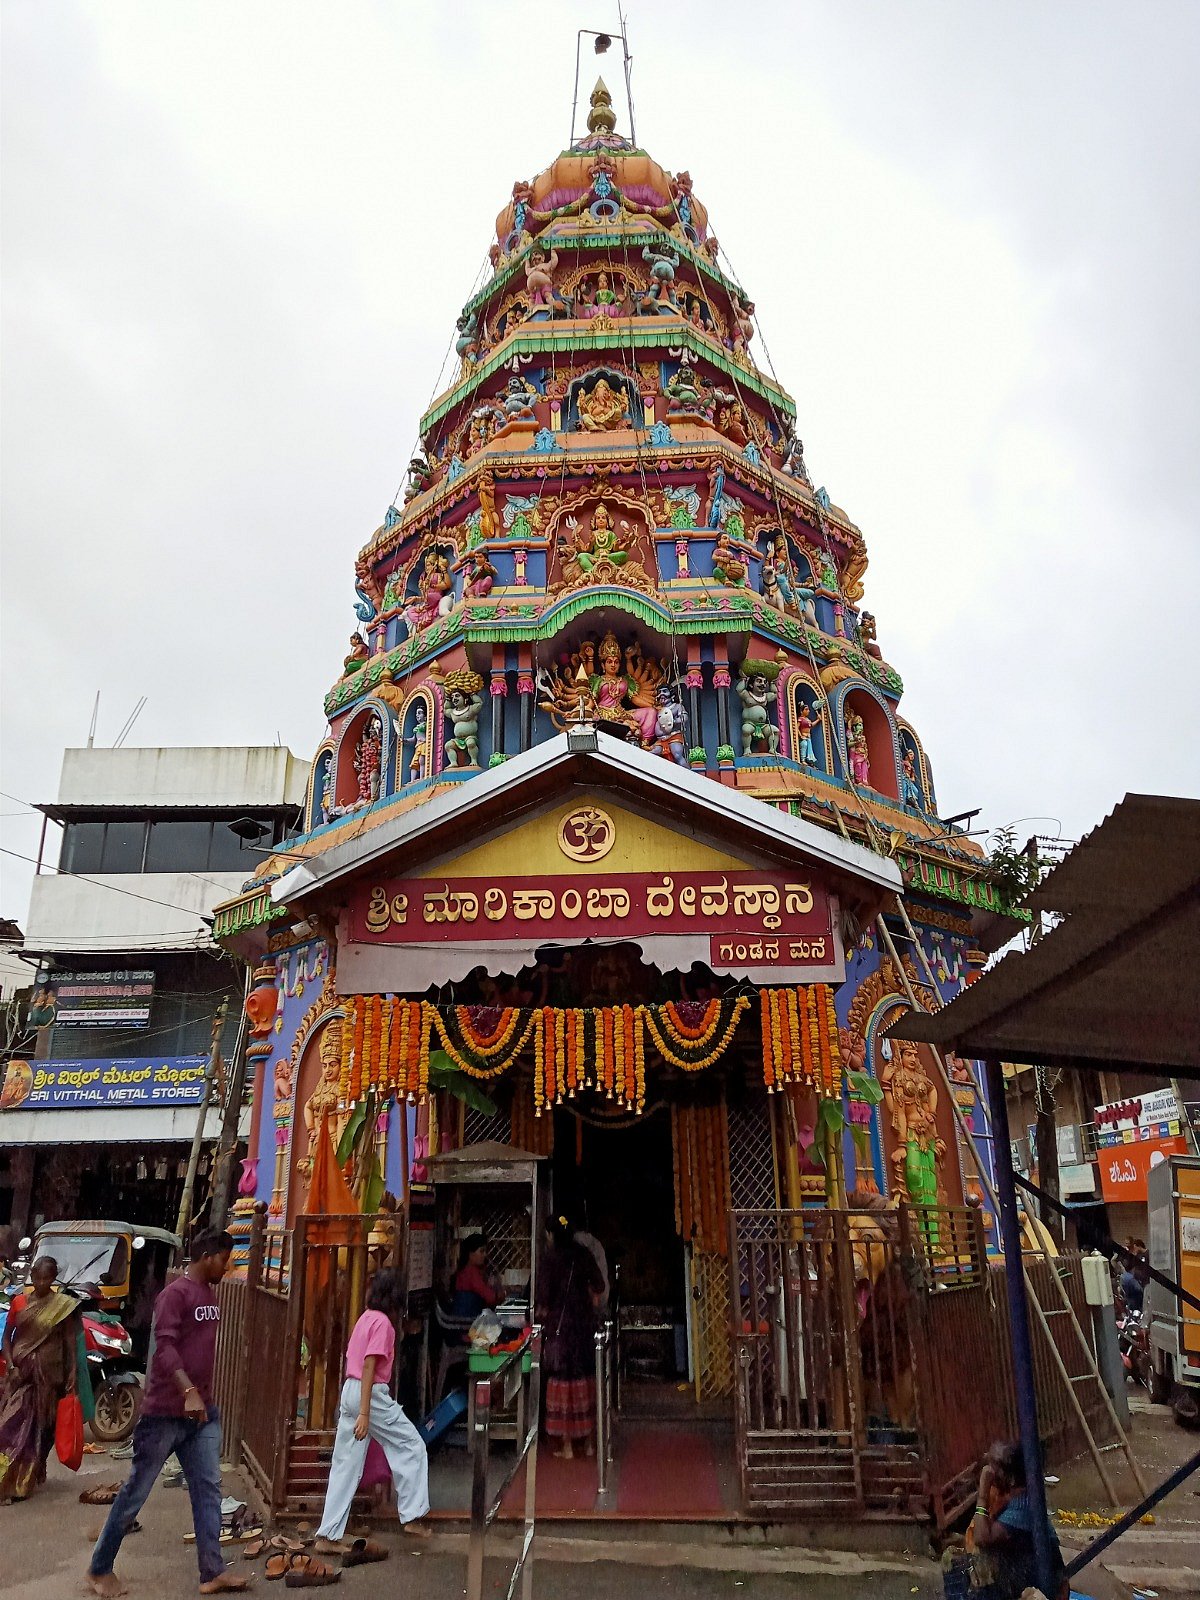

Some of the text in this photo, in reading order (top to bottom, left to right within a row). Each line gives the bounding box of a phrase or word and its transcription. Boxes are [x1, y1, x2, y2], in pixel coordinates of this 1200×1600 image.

[365, 876, 814, 933] ಶ್ರೀ ಮಾರಿಕಾಂಬಾ ದೇವಸ್ಥಾನ
[719, 936, 826, 961] ಗಂಡನ ಮನೆ
[33, 1069, 55, 1089] ಶ್ರೀ
[102, 1065, 151, 1084] ಮೆಟಲ್
[30, 1091, 50, 1101] SRI
[53, 1089, 104, 1101] VITTHAL
[107, 1088, 149, 1100] METAL
[151, 1086, 201, 1099] STORES
